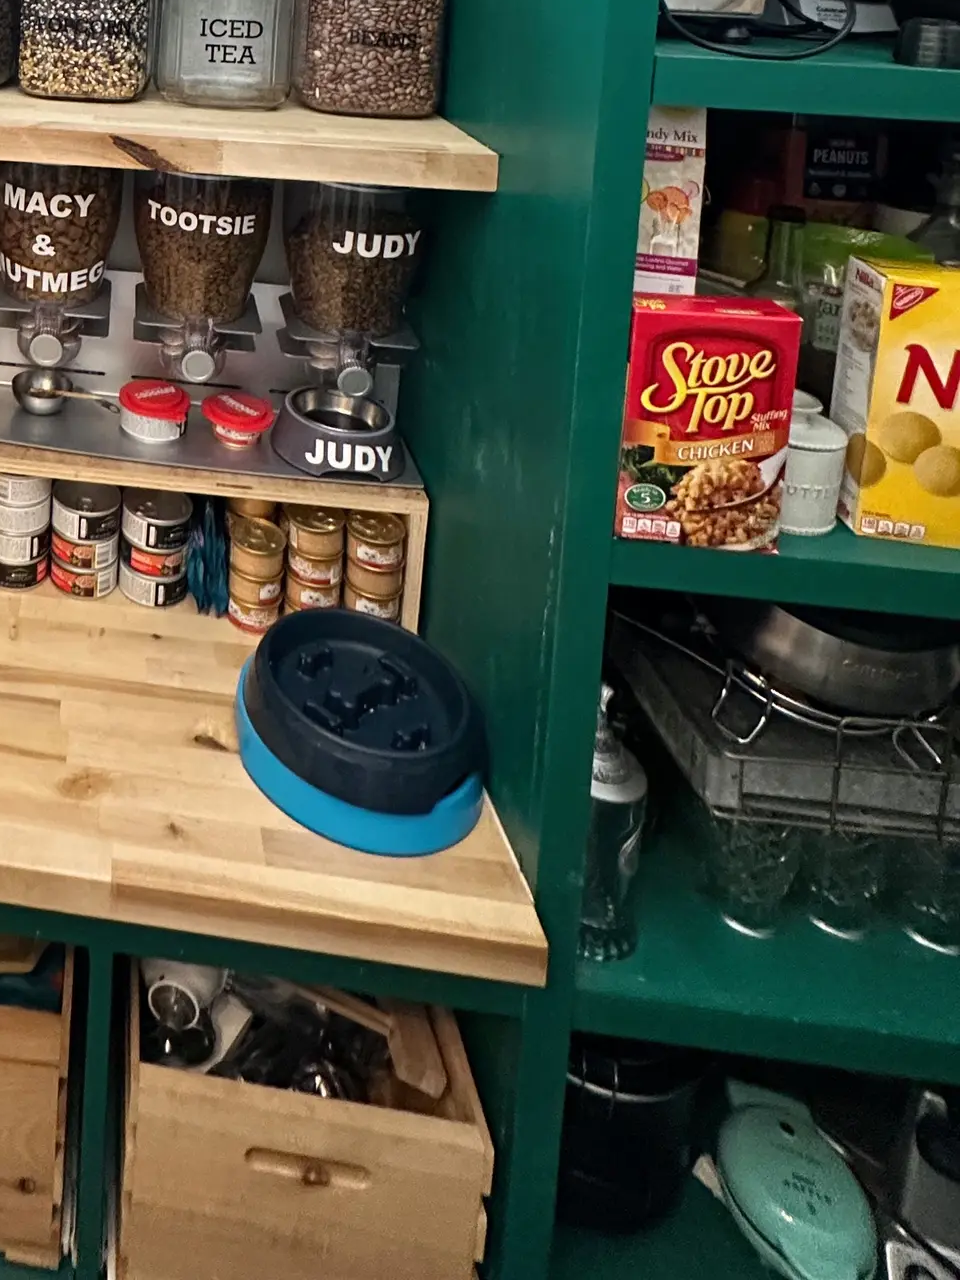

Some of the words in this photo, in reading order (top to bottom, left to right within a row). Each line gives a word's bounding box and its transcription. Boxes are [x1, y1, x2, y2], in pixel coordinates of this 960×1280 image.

[199, 17, 264, 40] ICED
[205, 43, 257, 65] TEA
[647, 128, 669, 143] ndy
[673, 129, 698, 144] Mix
[813, 148, 869, 165] PEANUTS
[4, 182, 97, 218] MACY
[147, 198, 257, 236] TOOTSIE
[31, 233, 57, 257] &
[332, 229, 422, 259] JUDY
[641, 341, 776, 413] Stove
[685, 388, 754, 433] Top
[750, 409, 788, 424] Stuffing
[752, 422, 771, 433] Mix
[304, 439, 393, 472] JUDY
[677, 438, 754, 460] CHICKEN
[640, 492, 651, 504] 5
